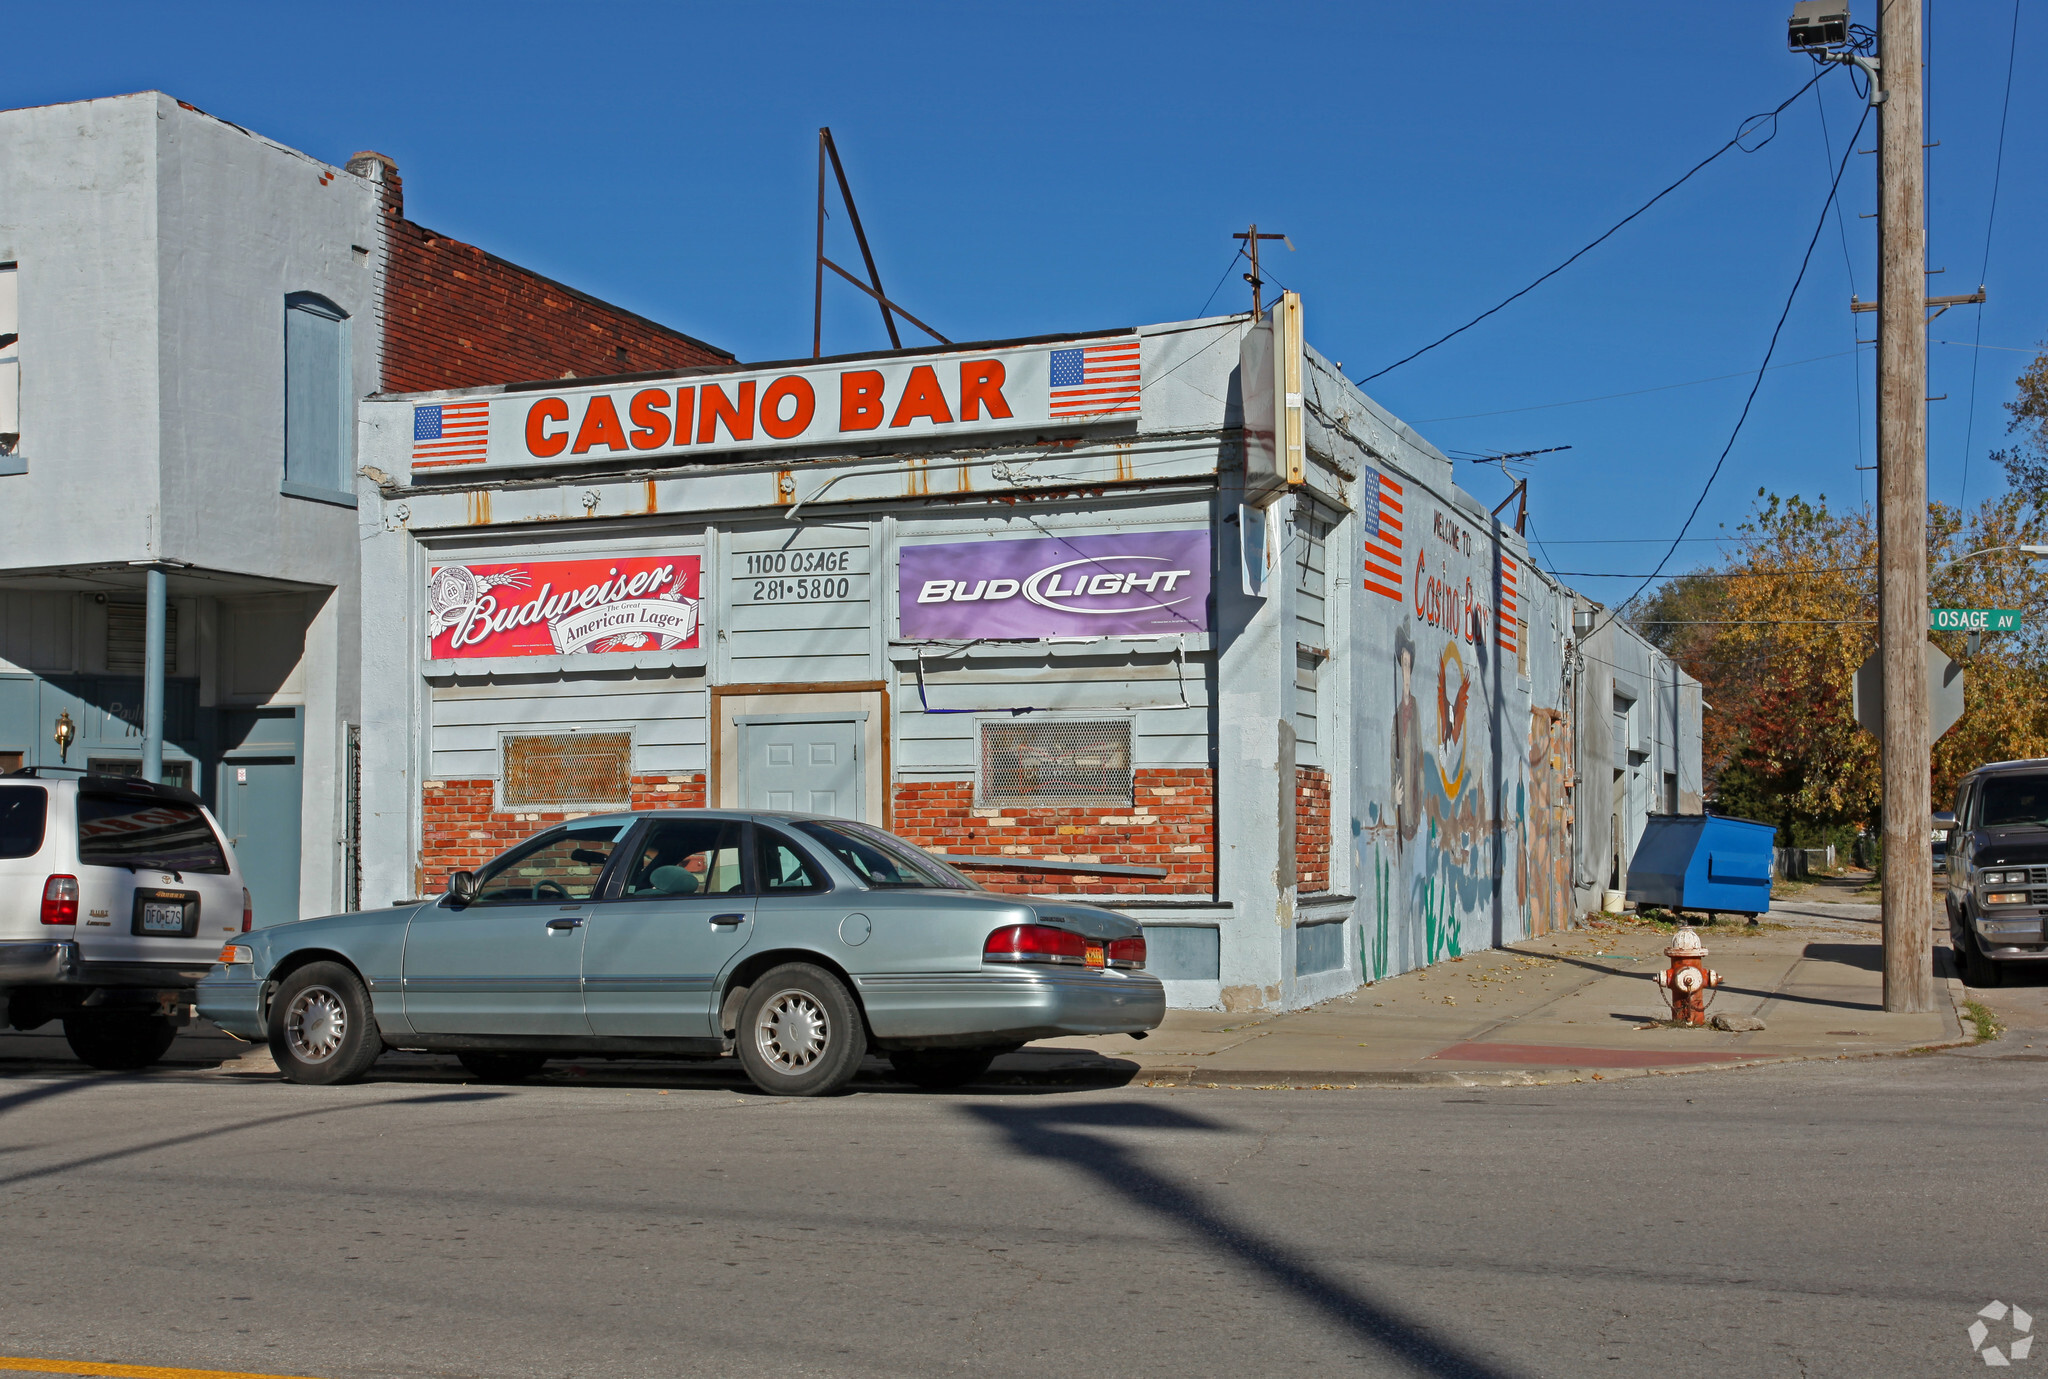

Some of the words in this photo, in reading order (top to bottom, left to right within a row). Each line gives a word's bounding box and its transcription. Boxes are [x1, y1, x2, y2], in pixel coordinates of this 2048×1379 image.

[525, 374, 816, 458] CASINO
[838, 358, 1014, 433] BAR
[1433, 508, 1459, 552] WELCOME
[1462, 530, 1472, 559] TO
[747, 553, 786, 574] 1100
[790, 551, 849, 572] OSAGE
[917, 579, 1020, 604] BUD
[1045, 570, 1191, 597] LIGHT
[1414, 547, 1460, 639] Casino
[1464, 576, 1489, 646] Bar
[441, 564, 674, 649] Budweiser
[606, 604, 620, 612] The
[621, 602, 641, 610] Great
[1938, 611, 1989, 627] OSAGE
[1997, 615, 2013, 628] AV
[566, 611, 638, 645] American
[640, 608, 684, 628] Lager
